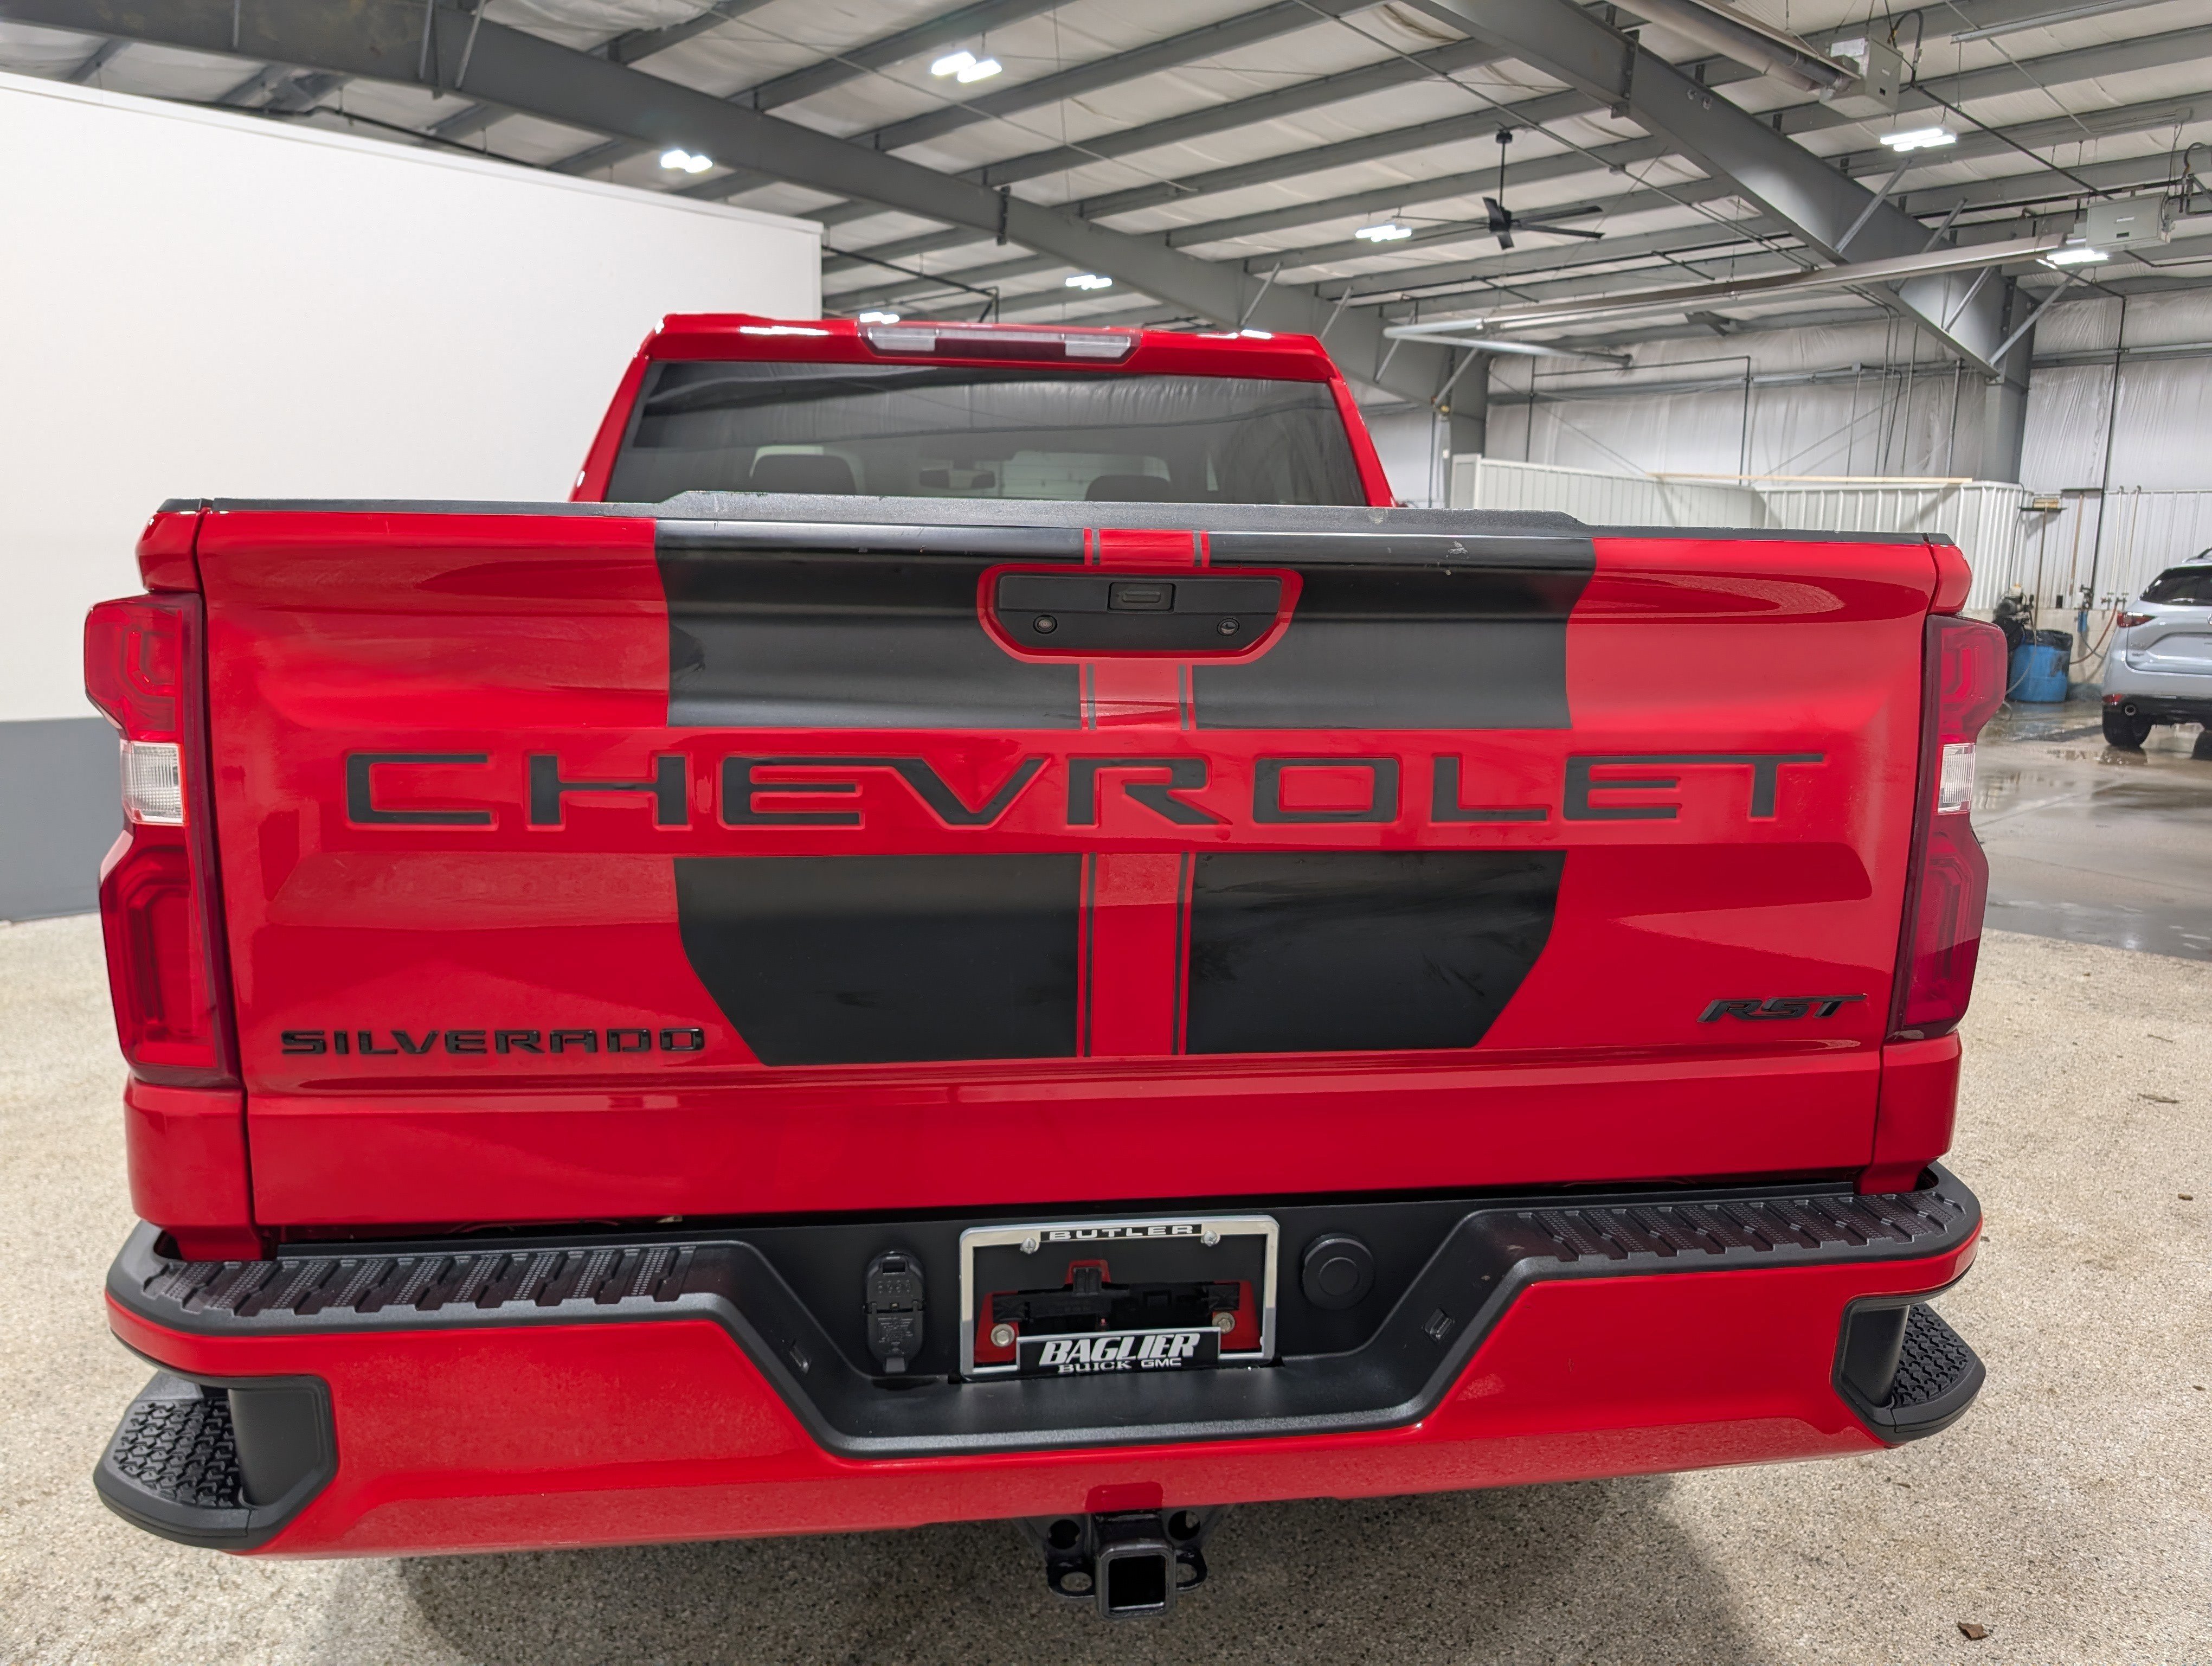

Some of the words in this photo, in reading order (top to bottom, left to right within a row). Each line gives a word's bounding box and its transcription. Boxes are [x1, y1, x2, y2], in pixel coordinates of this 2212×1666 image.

[344, 752, 1824, 826] CHEVROLET
[1696, 993, 1868, 1023] RST
[280, 1027, 705, 1055] SILVERADO
[1049, 1225, 1193, 1241] BUTLER
[1038, 1332, 1201, 1367] BAGLIER
[1057, 1360, 1132, 1374] BUICK
[1141, 1357, 1182, 1369] GMC
